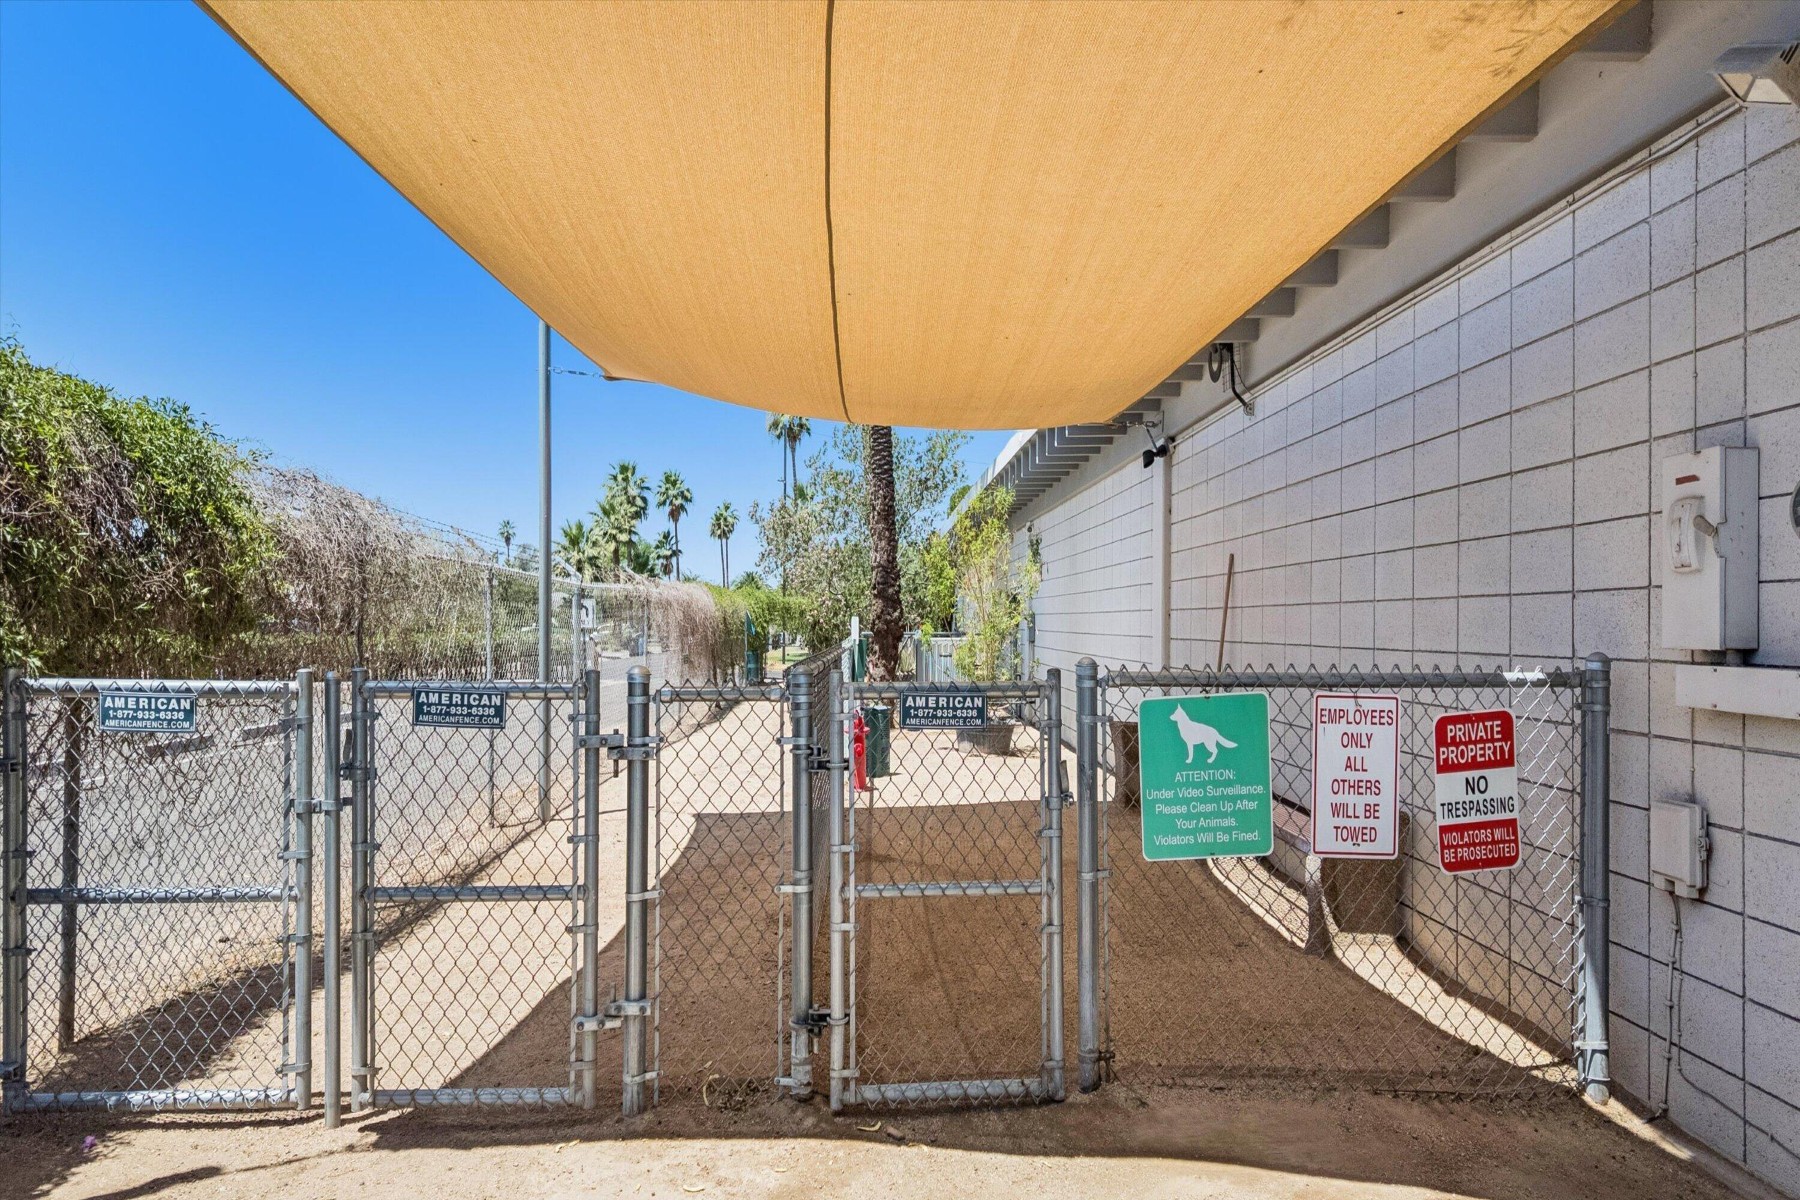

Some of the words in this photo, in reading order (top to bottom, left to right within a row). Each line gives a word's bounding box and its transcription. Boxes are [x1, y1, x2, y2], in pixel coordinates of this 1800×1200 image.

[105, 697, 190, 709] AMERICAN
[419, 692, 500, 705] AMERICAN
[906, 697, 982, 707] AMERICAN
[109, 710, 184, 719] 1-877-933-6336
[423, 706, 494, 715] 1-877-933-6336
[910, 709, 977, 717] 1-877-933-6336
[1320, 708, 1394, 726] EMPLOYEES
[105, 720, 189, 728] AMERICANFENCE.COM
[419, 715, 499, 724] AMERICANFENCE.COM
[1447, 721, 1502, 743] PRIVATE
[1341, 732, 1373, 748] ONLY
[1440, 741, 1511, 766] PROPERTY
[1344, 756, 1368, 772] ALL
[1175, 770, 1236, 782] ATTENTION:
[1146, 789, 1174, 799] Under
[1177, 787, 1204, 798] Video
[1206, 785, 1266, 797] Surveillance.
[1331, 779, 1381, 796] OTHERS
[1465, 775, 1488, 795] NO
[1155, 804, 1187, 814] Please
[1190, 802, 1217, 813] Clean
[1220, 801, 1234, 812] Up
[1236, 800, 1258, 810] After
[1331, 802, 1360, 819] WILL
[1364, 803, 1380, 819] BE
[1440, 796, 1515, 820] TRESPASSING
[1176, 818, 1196, 829] Your
[1199, 816, 1238, 828] Animals.
[1154, 834, 1194, 846] Violators
[1197, 832, 1213, 843] Will
[1216, 832, 1229, 843] Be
[1232, 831, 1261, 842] Fined.
[1333, 826, 1377, 843] TOWED
[1443, 829, 1492, 846] VIOLATORS
[1493, 827, 1515, 841] WILL
[1444, 850, 1455, 863] BE
[1457, 843, 1516, 862] PROSECUTED
